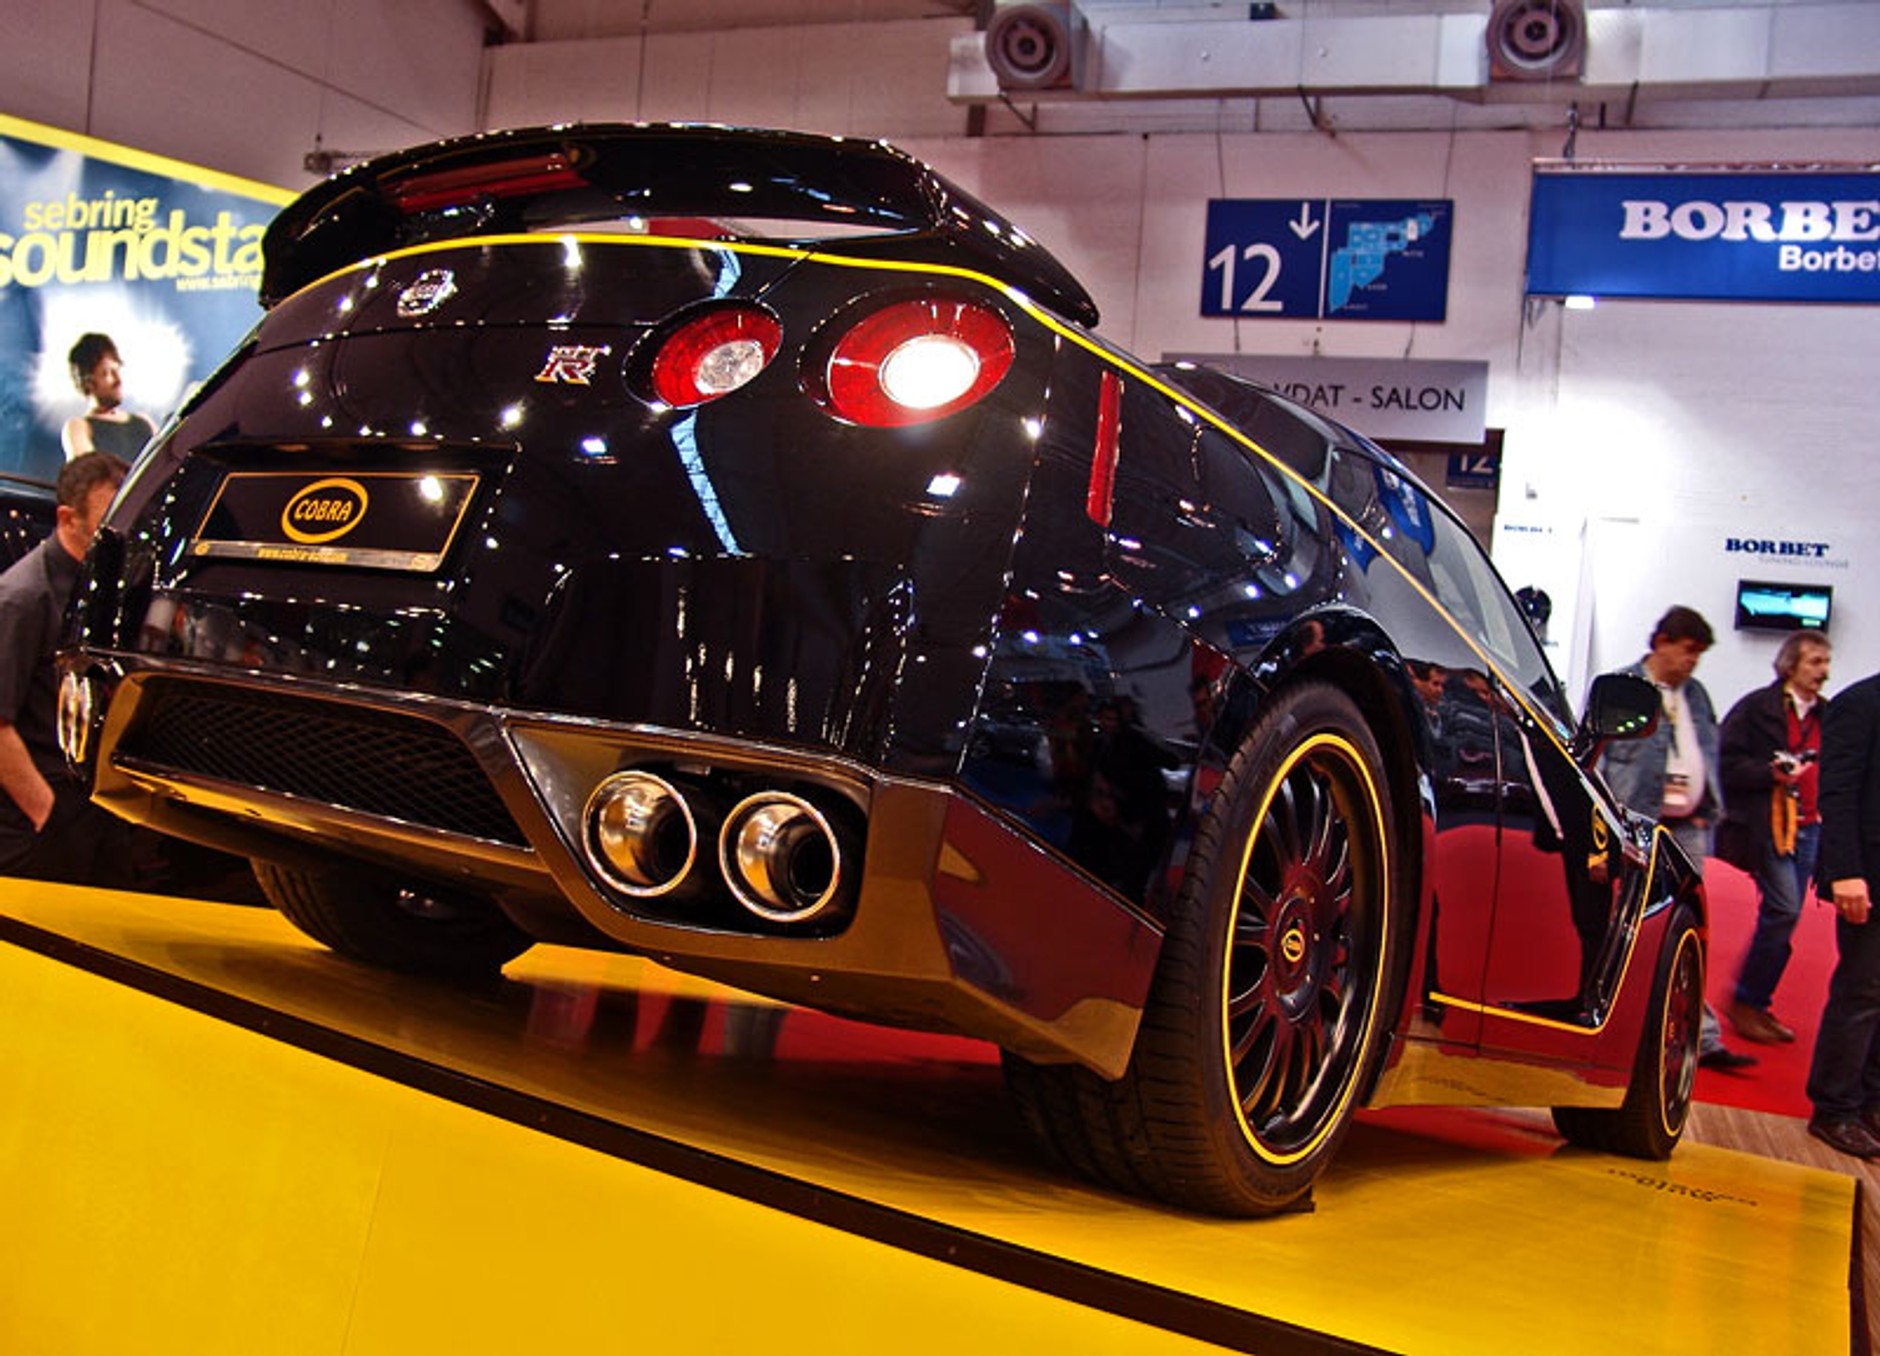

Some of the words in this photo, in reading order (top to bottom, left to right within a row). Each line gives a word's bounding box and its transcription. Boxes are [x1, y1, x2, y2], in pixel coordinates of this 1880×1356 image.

[24, 190, 158, 233] sebring
[1619, 201, 1880, 240] BORBE
[1779, 245, 1880, 272] Borbe
[1208, 243, 1284, 311] 12
[1371, 385, 1466, 412] SALON
[294, 499, 353, 522] COBRA
[1725, 538, 1830, 557] BORBET
